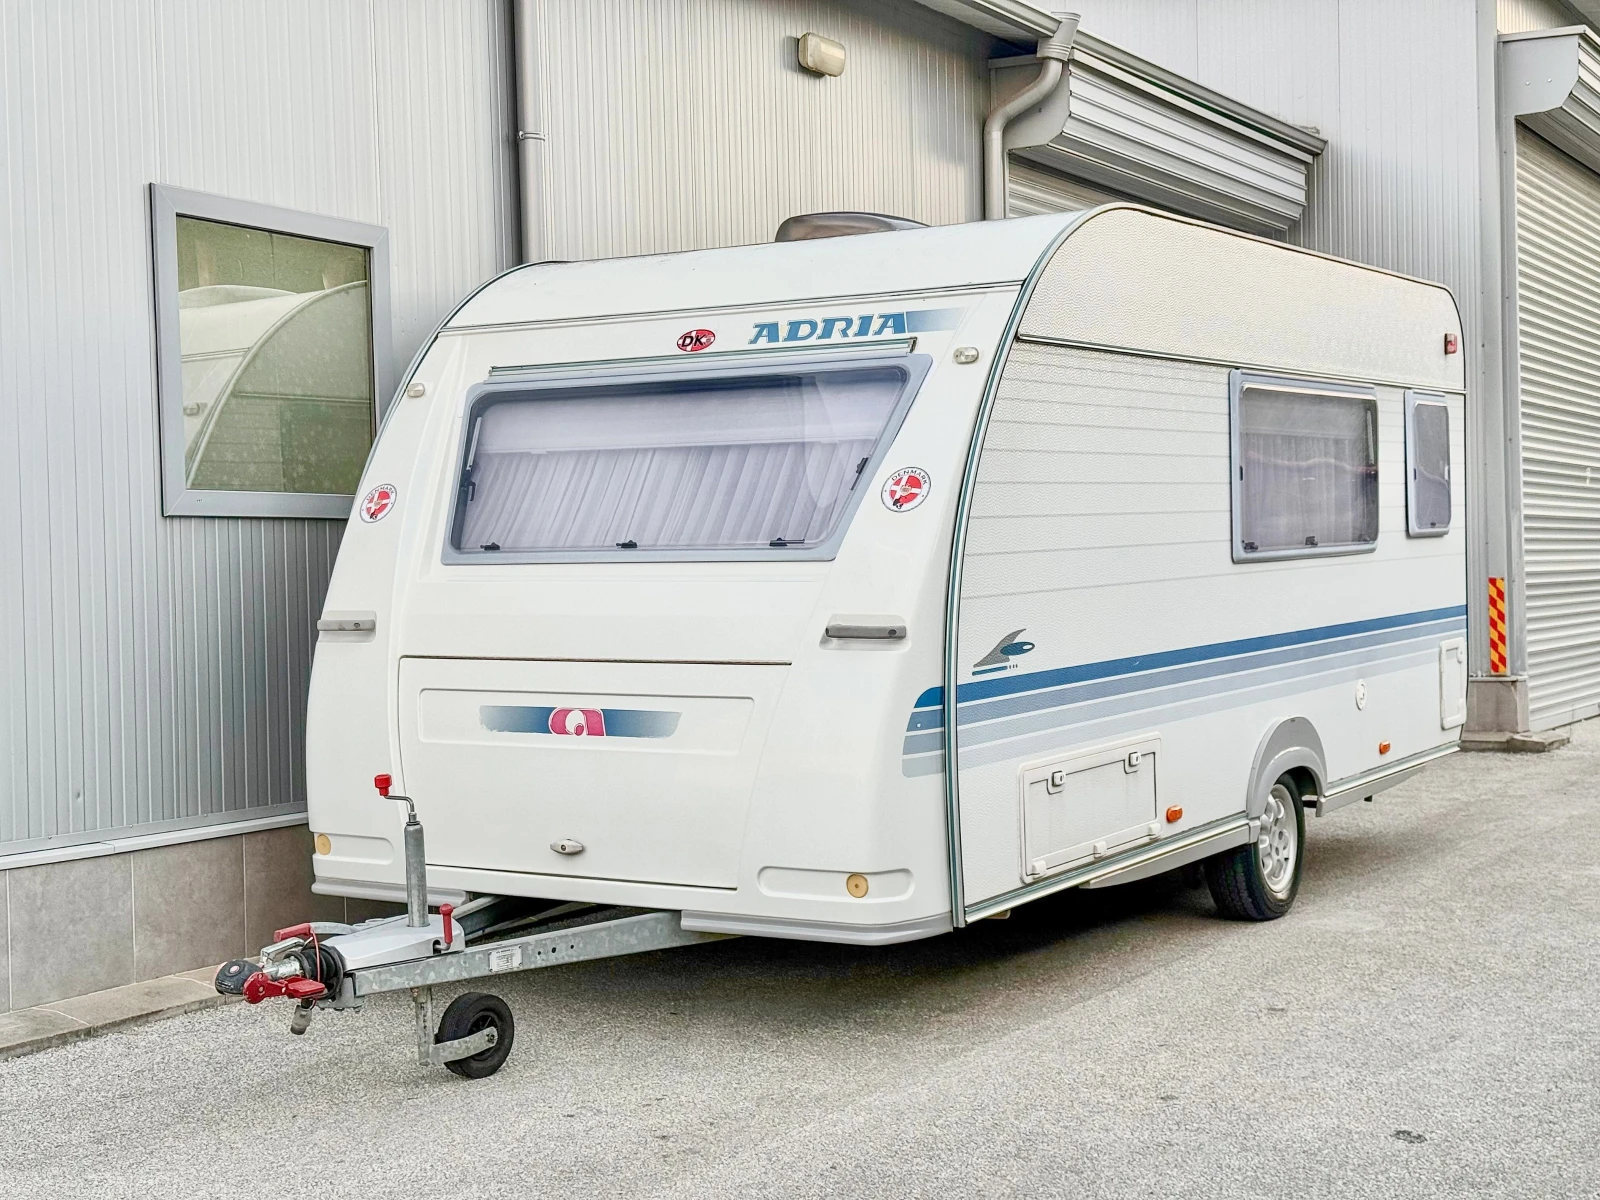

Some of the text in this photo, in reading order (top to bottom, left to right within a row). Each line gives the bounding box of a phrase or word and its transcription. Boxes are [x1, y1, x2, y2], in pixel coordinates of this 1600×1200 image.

[748, 311, 907, 344] ADRIA
[681, 333, 707, 348] DK
[891, 469, 928, 486] DENMARK
